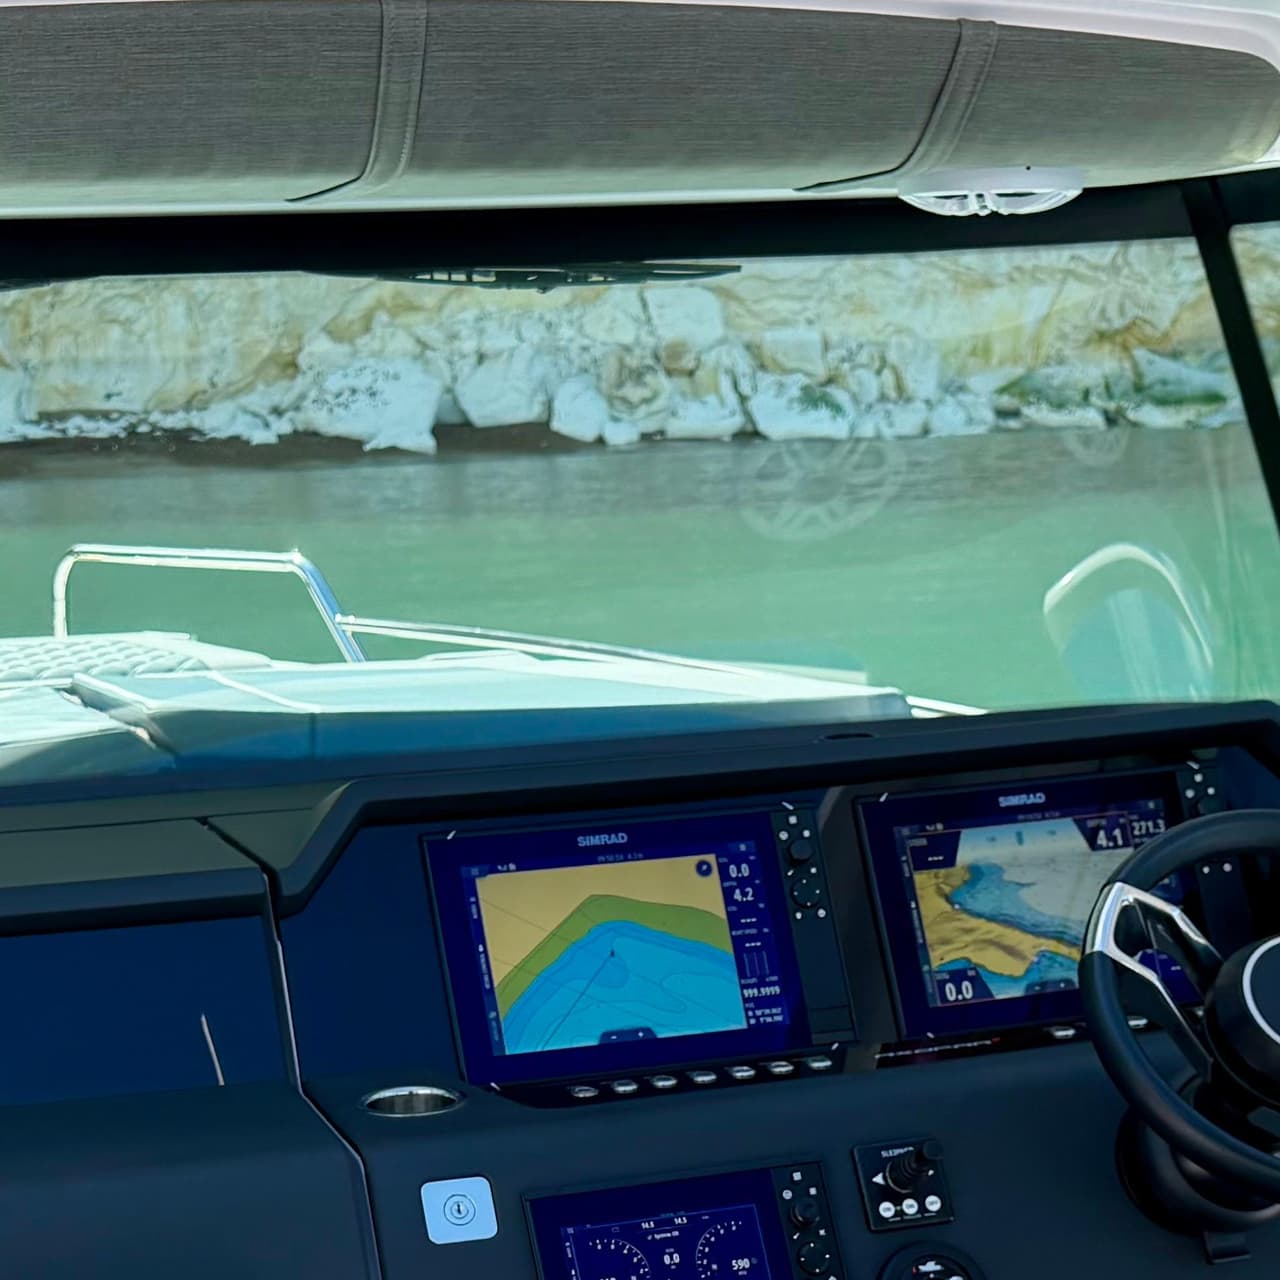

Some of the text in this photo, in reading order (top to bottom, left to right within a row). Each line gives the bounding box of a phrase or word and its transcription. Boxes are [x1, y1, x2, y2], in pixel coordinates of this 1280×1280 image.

[998, 793, 1046, 807] SIMRAD
[577, 833, 628, 847] SIMRAD
[1097, 828, 1123, 848] 4.1
[729, 863, 750, 878] 0.0
[733, 887, 755, 902] 4.2
[945, 980, 973, 1002] 0.0
[663, 1253, 680, 1265] 0.0
[732, 1258, 750, 1271] 590
